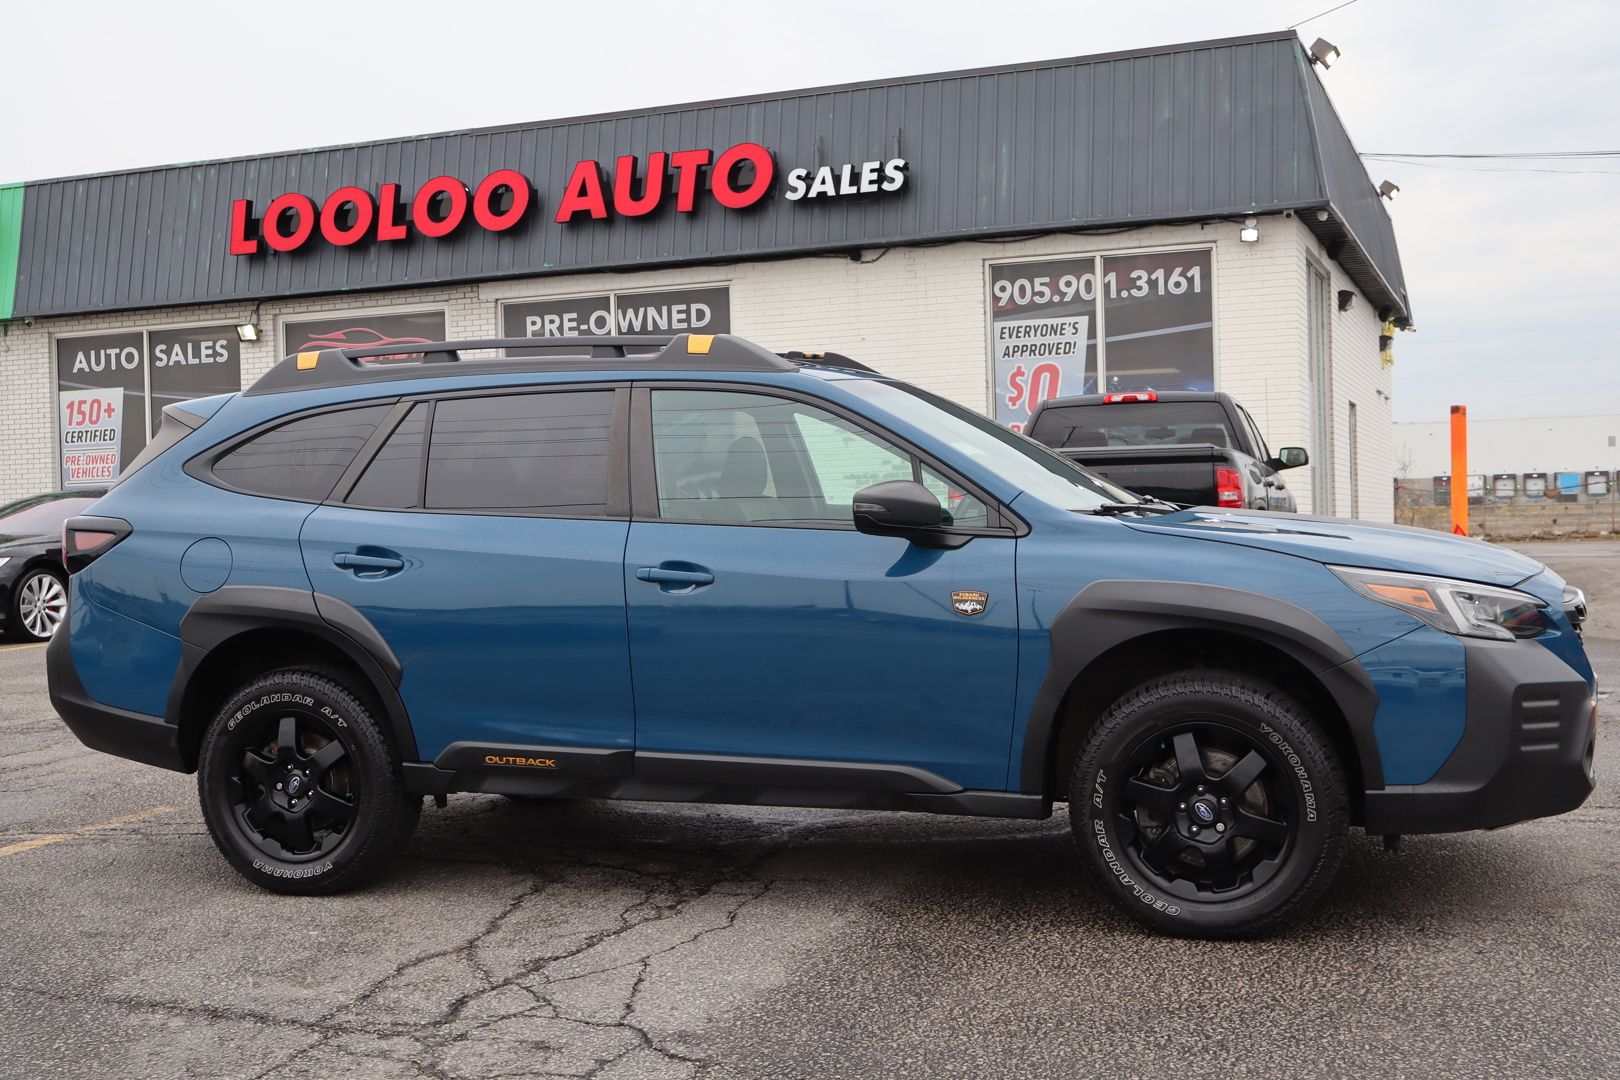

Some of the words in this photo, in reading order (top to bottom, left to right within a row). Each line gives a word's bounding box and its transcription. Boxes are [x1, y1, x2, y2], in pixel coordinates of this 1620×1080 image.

[230, 169, 531, 255] LOOLOO
[554, 142, 775, 223] AUTO
[785, 158, 907, 201] SALES
[993, 266, 1202, 307] 905.901.3161
[525, 303, 711, 338] PRE-OWNED
[999, 321, 1079, 340] EVERYONE'S
[73, 346, 139, 373] AUTO
[155, 339, 229, 367] SALES
[1002, 341, 1077, 359] APPROVED!
[1007, 363, 1060, 415] $0
[65, 398, 116, 427] 150+
[64, 428, 116, 444] CERTIFIED
[65, 453, 116, 466] PRE-OWNED
[70, 465, 112, 479] VEHICLES
[227, 693, 315, 731] GEOLANDAR
[320, 706, 347, 728] A/T
[485, 755, 556, 768] OUTBACK
[1258, 722, 1317, 822] YOKOHAMA
[1093, 769, 1108, 808] A/T
[252, 861, 333, 879] YOKOHAMA
[1094, 819, 1181, 916] GEOLANDAR
